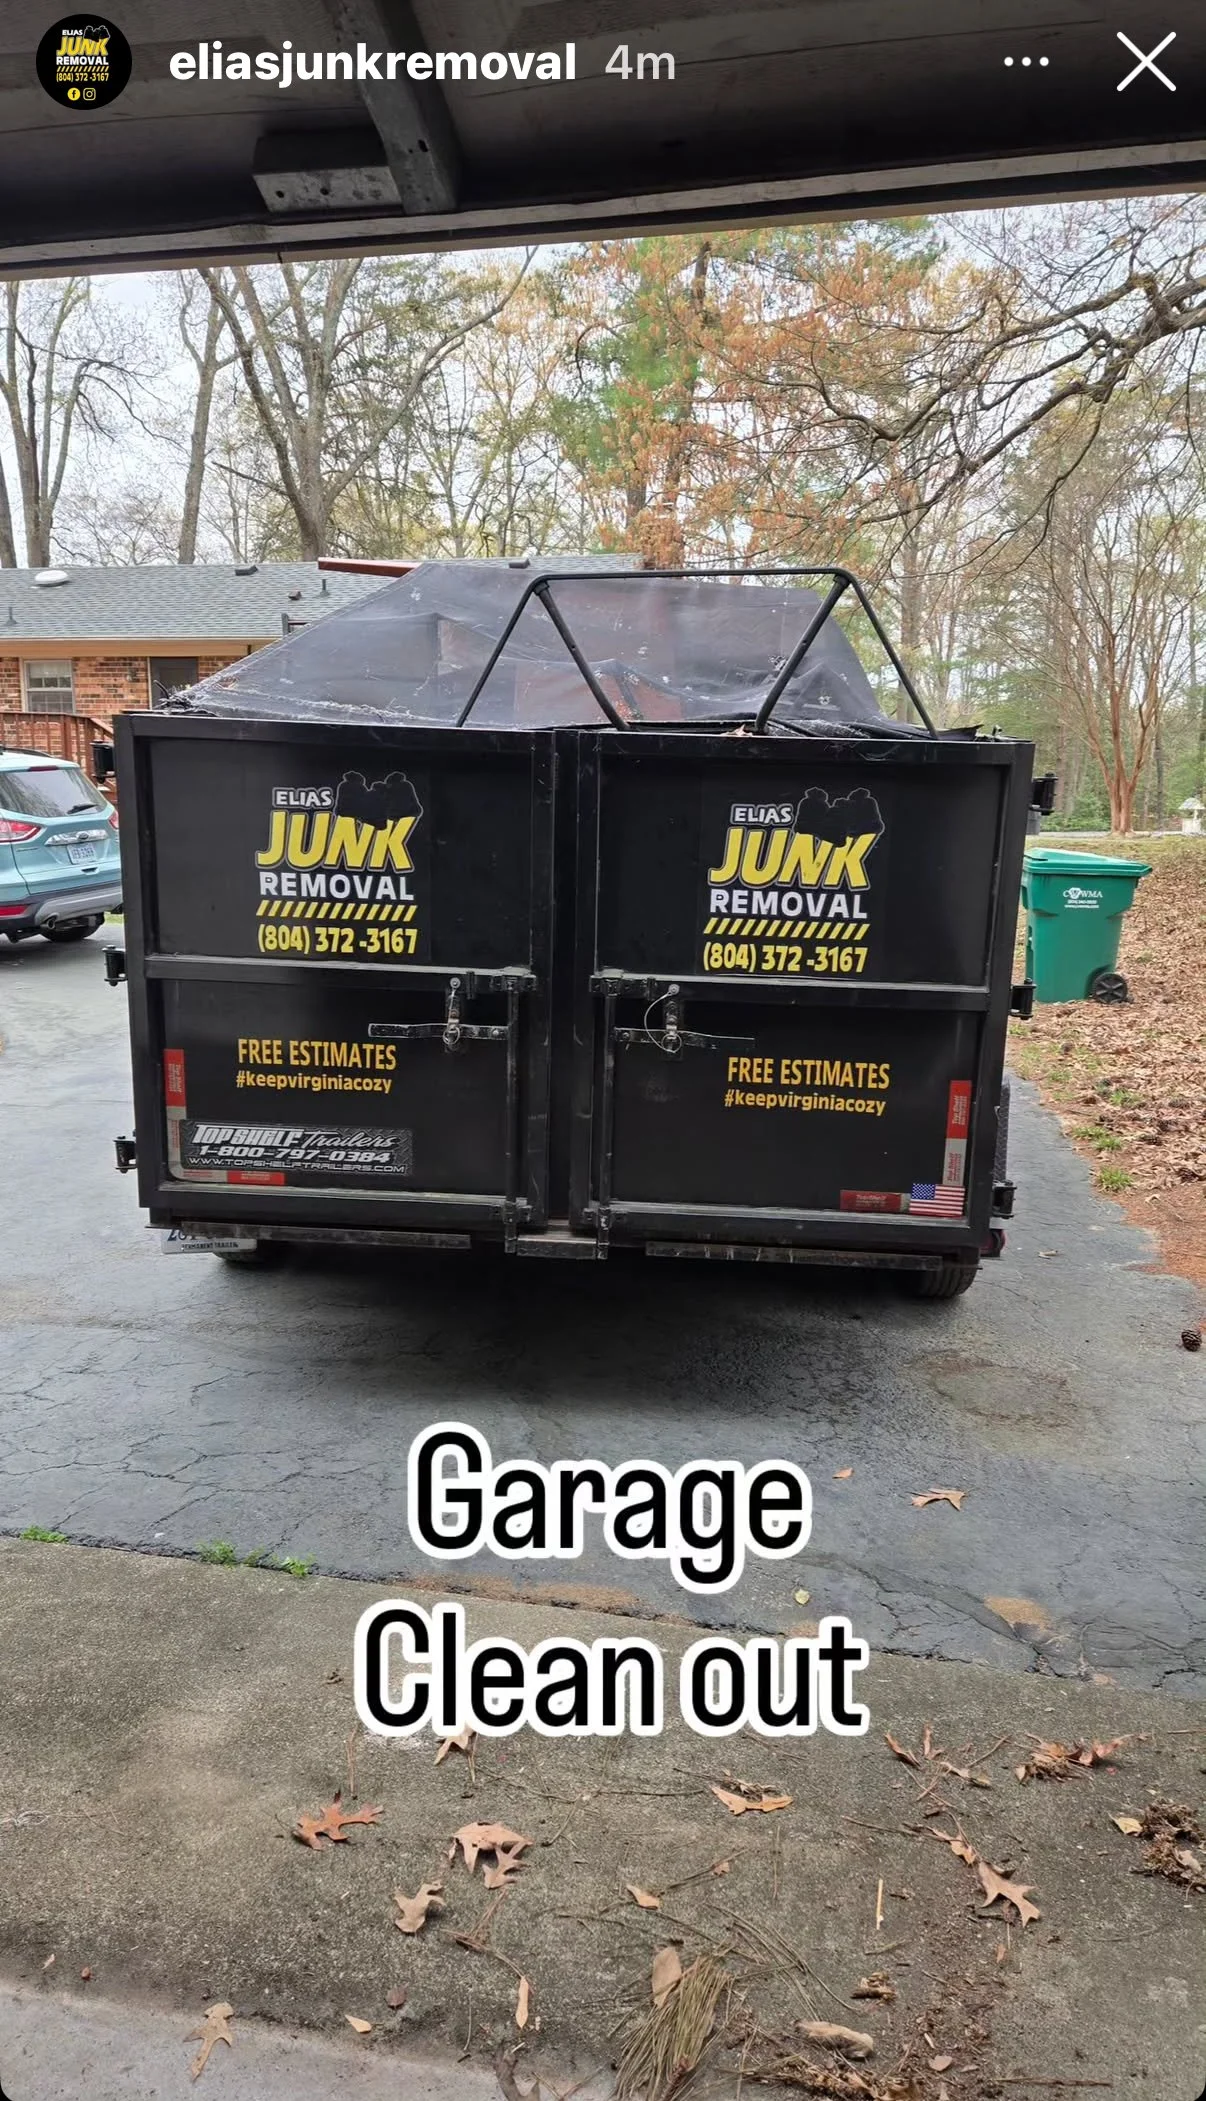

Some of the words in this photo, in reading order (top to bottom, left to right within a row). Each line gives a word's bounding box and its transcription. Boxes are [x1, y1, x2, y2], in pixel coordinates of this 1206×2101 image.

[275, 790, 333, 807] ELIAS
[733, 806, 794, 824] ELIAS
[256, 811, 417, 871] JUNK
[709, 827, 877, 888] JUNK
[259, 871, 414, 901] REMOVAL
[709, 888, 868, 919] REMOVAL
[257, 923, 311, 955] (804)
[315, 926, 355, 954] 372
[359, 927, 418, 955] -3167
[703, 941, 757, 973] (804)
[761, 944, 803, 972] 372
[806, 946, 869, 973] -3167
[237, 1038, 284, 1066] FREE
[288, 1040, 398, 1071] ESTIMATES
[235, 1070, 393, 1094] #keepvirginiacozy
[727, 1056, 775, 1085] FREE
[779, 1058, 891, 1090] ESTIMATES
[724, 1088, 887, 1117] #keepvirginiacozy
[199, 1144, 391, 1164] 1-800-797-0384
[301, 1130, 398, 1149] Trailers
